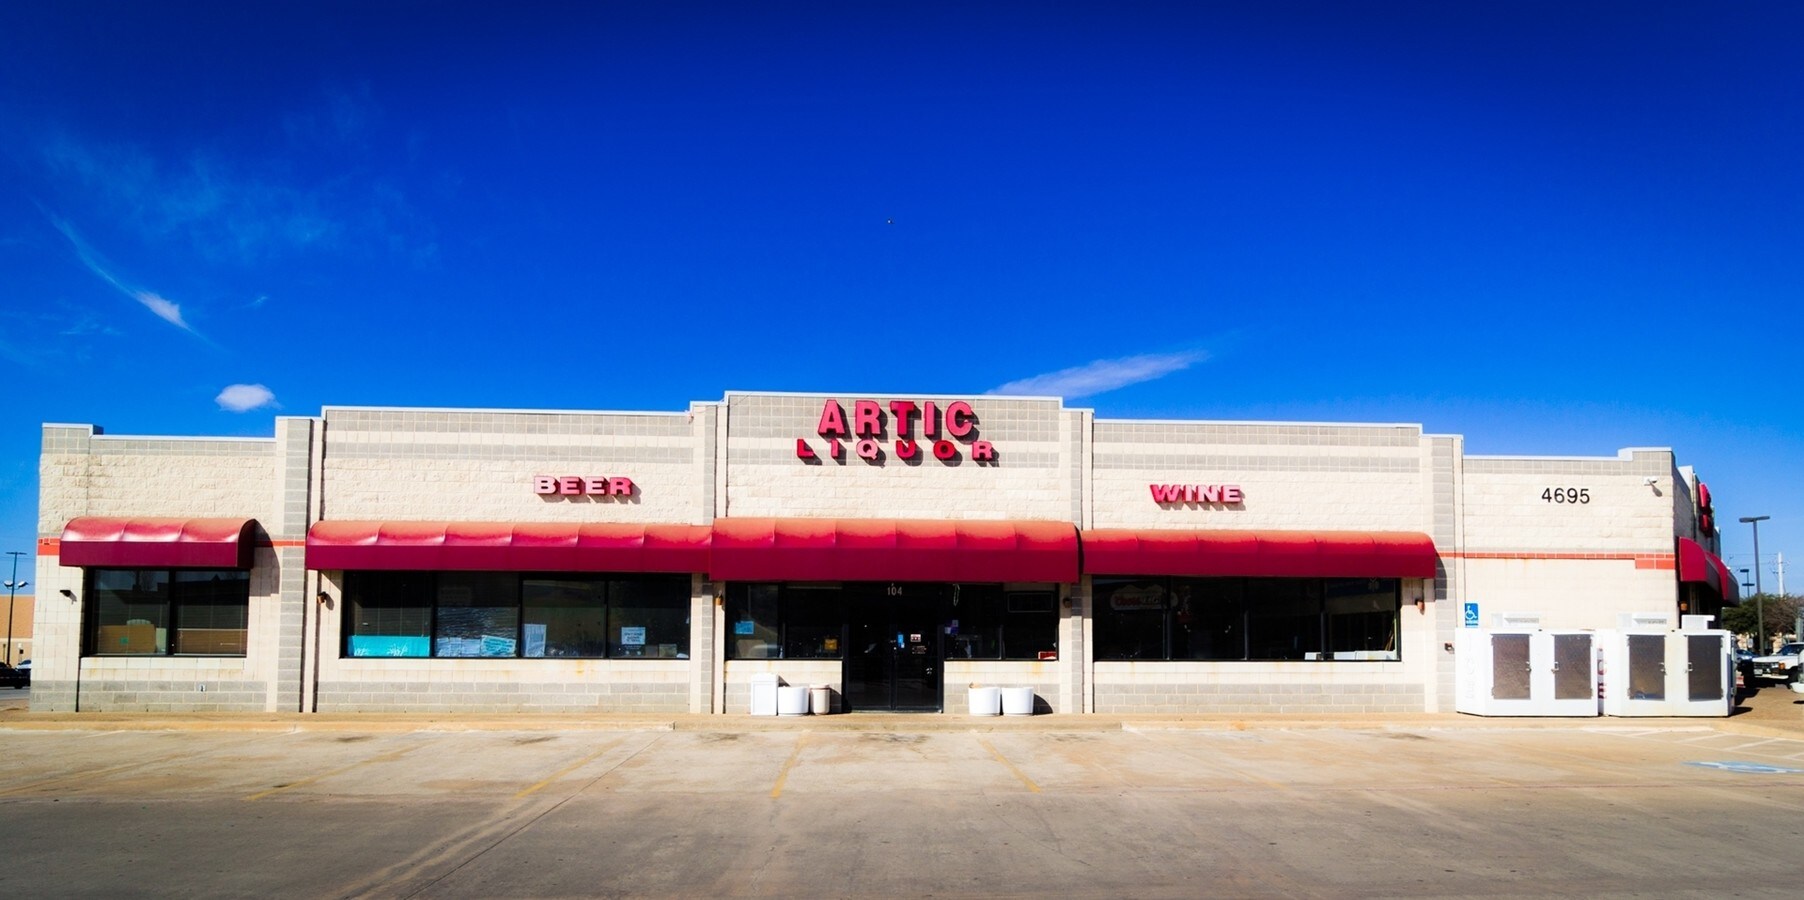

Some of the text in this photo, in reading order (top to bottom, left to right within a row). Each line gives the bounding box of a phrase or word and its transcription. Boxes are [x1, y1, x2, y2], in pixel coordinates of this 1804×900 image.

[817, 399, 975, 437] ARTIC
[797, 439, 993, 461] LIQUOR
[534, 475, 634, 496] BEER
[1149, 484, 1242, 503] WINE
[1541, 487, 1590, 504] 4695
[887, 586, 903, 596] 104
